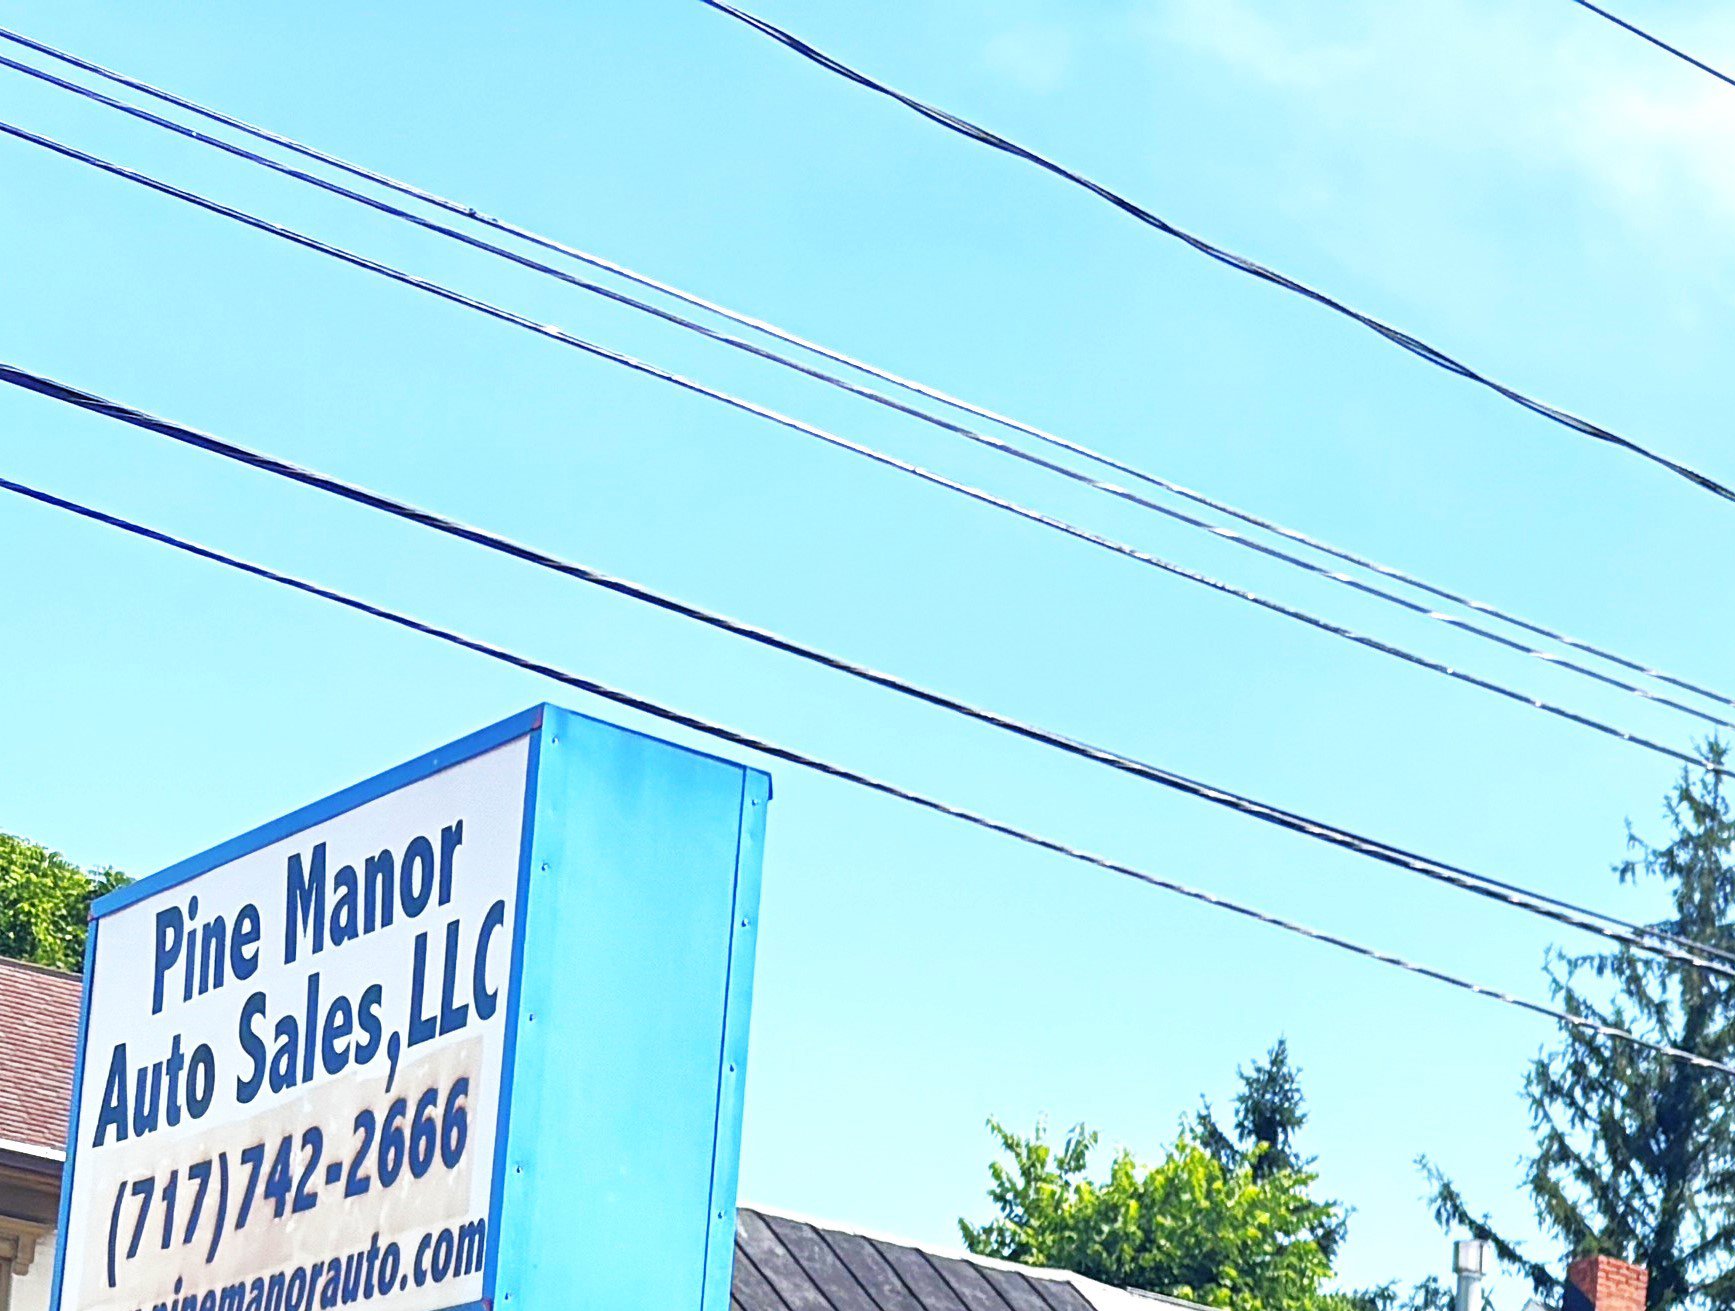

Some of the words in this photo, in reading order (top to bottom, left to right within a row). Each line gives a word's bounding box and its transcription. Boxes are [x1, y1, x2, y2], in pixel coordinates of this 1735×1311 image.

[152, 896, 260, 1015] Pine
[284, 819, 464, 964] Manor
[92, 1034, 215, 1148] Auto
